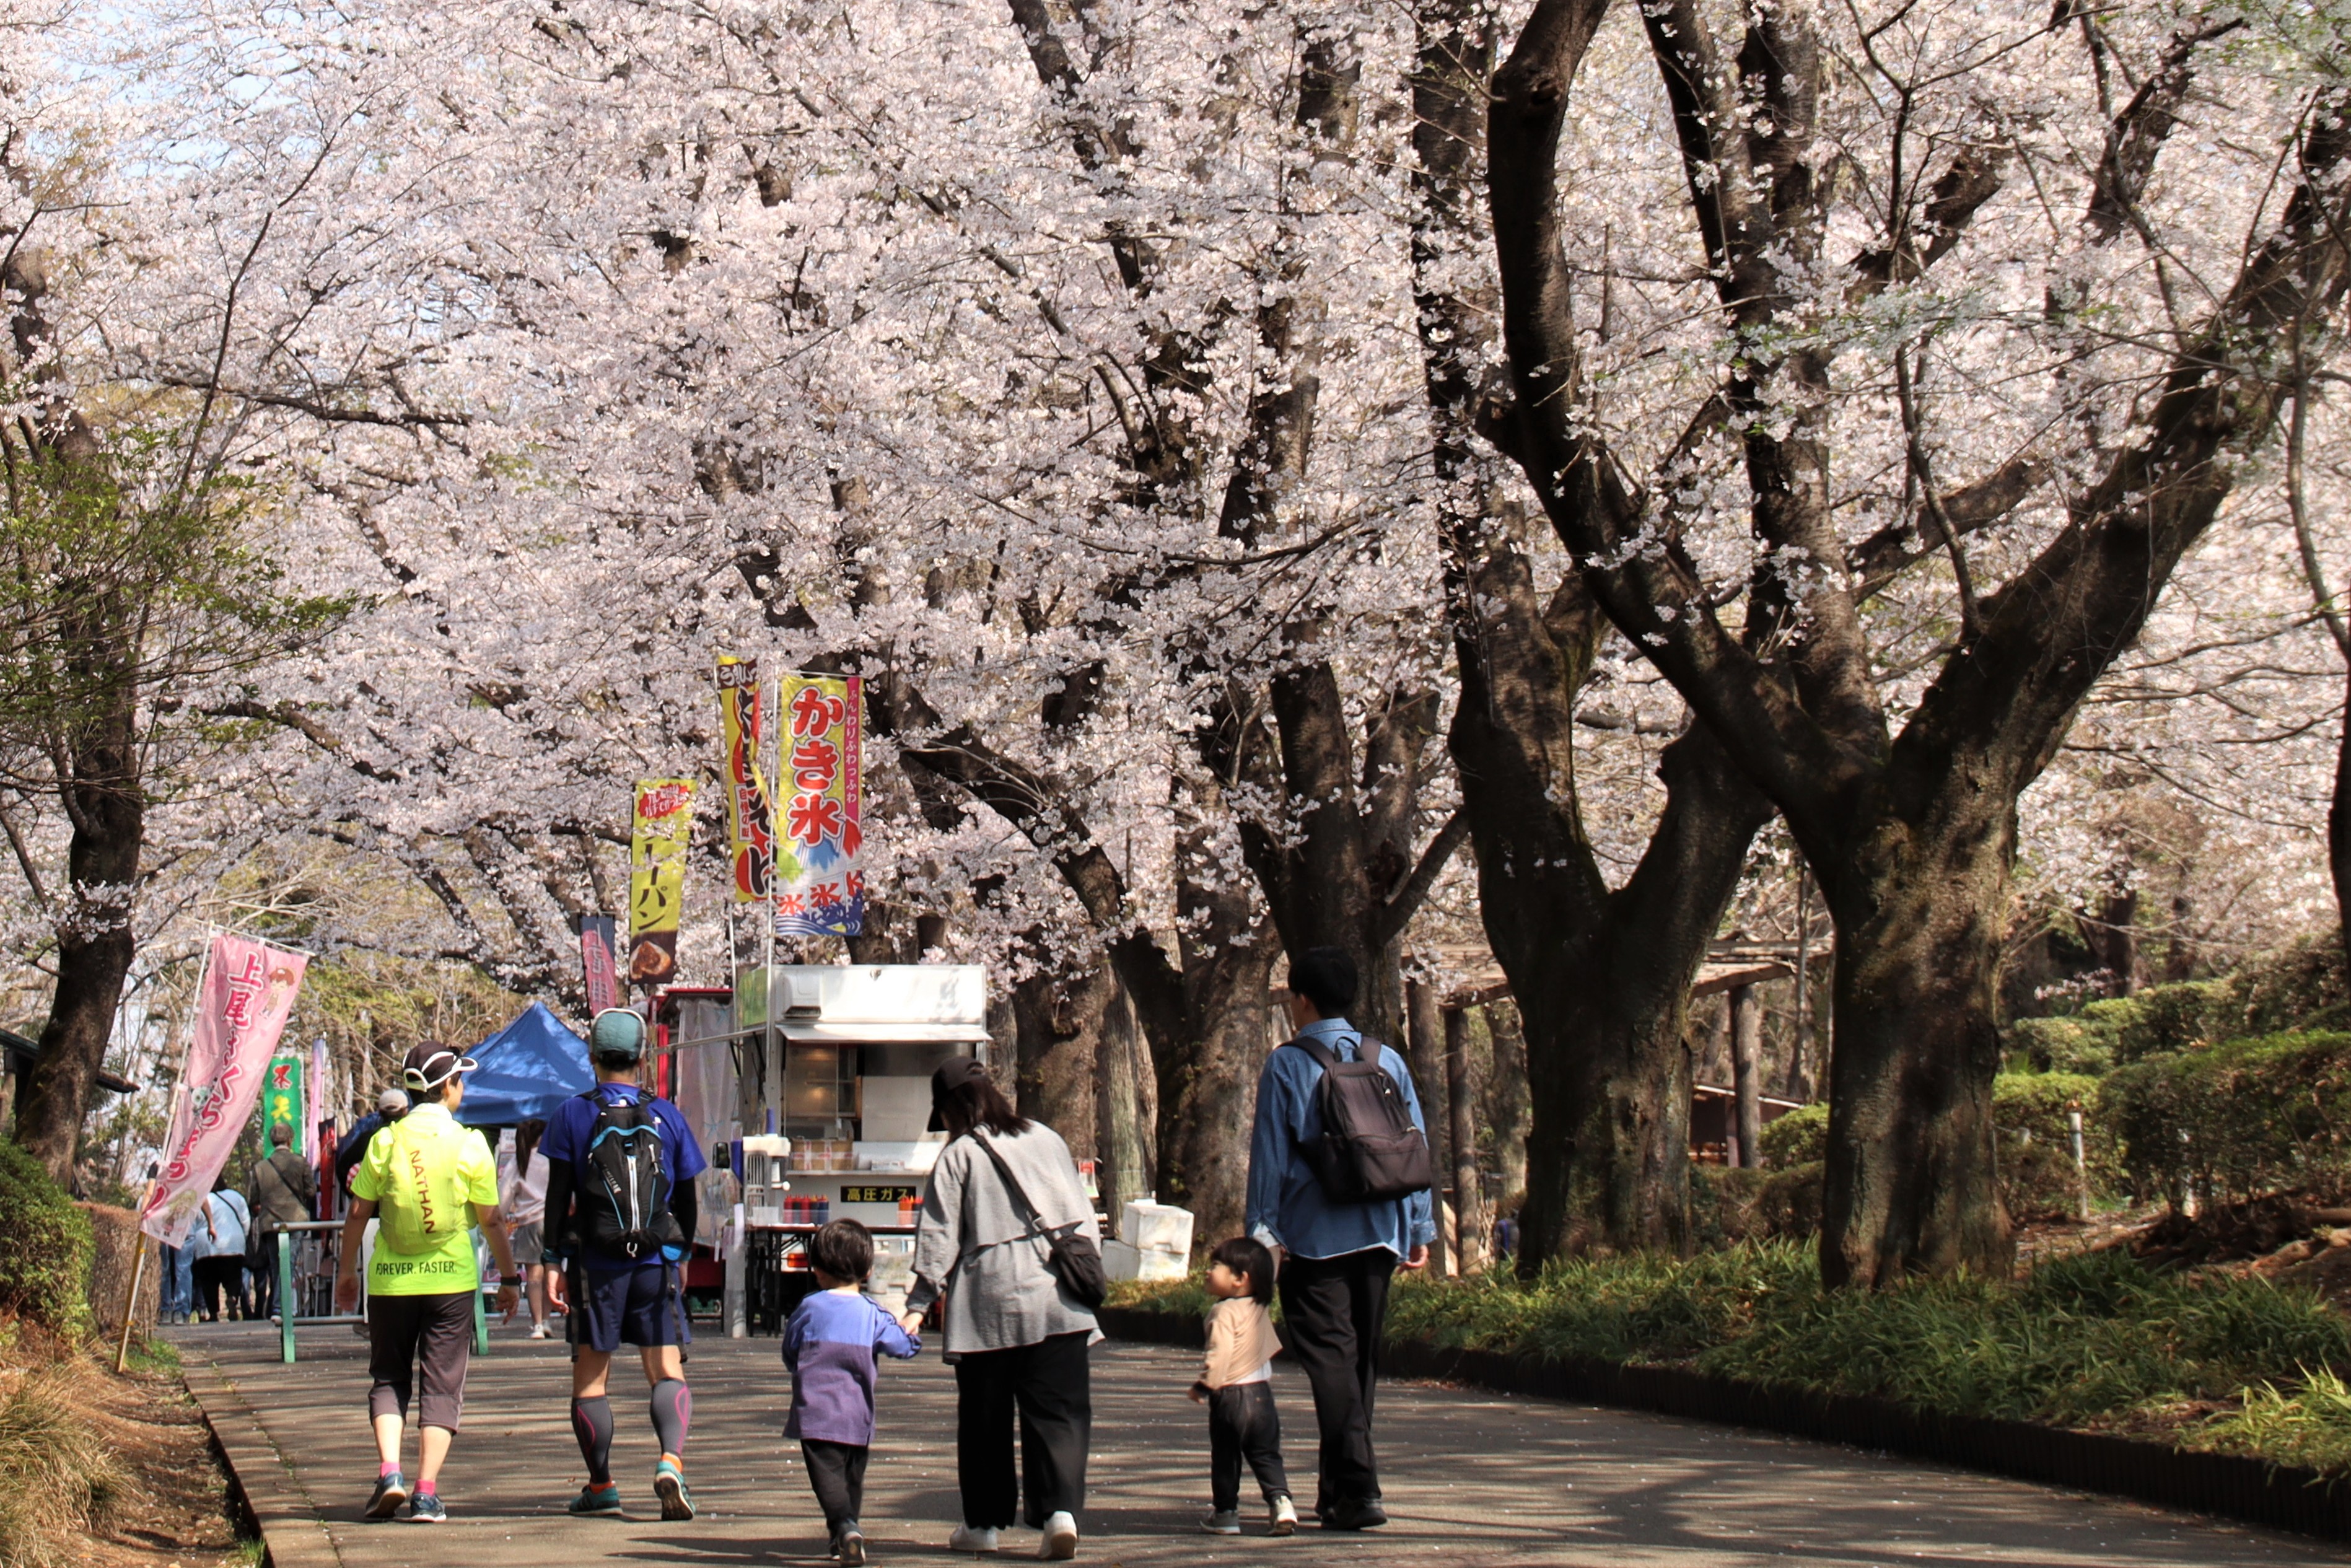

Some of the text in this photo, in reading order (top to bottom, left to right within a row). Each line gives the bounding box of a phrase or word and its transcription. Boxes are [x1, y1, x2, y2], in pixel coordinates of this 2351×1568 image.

[789, 687, 845, 846] かき氷
[845, 690, 857, 804] ふんわりふわっふわ
[410, 1150, 436, 1234] NATHAN
[847, 1187, 909, 1201] 高圧ガス
[376, 1260, 457, 1276] FOREVER. FASTER.
